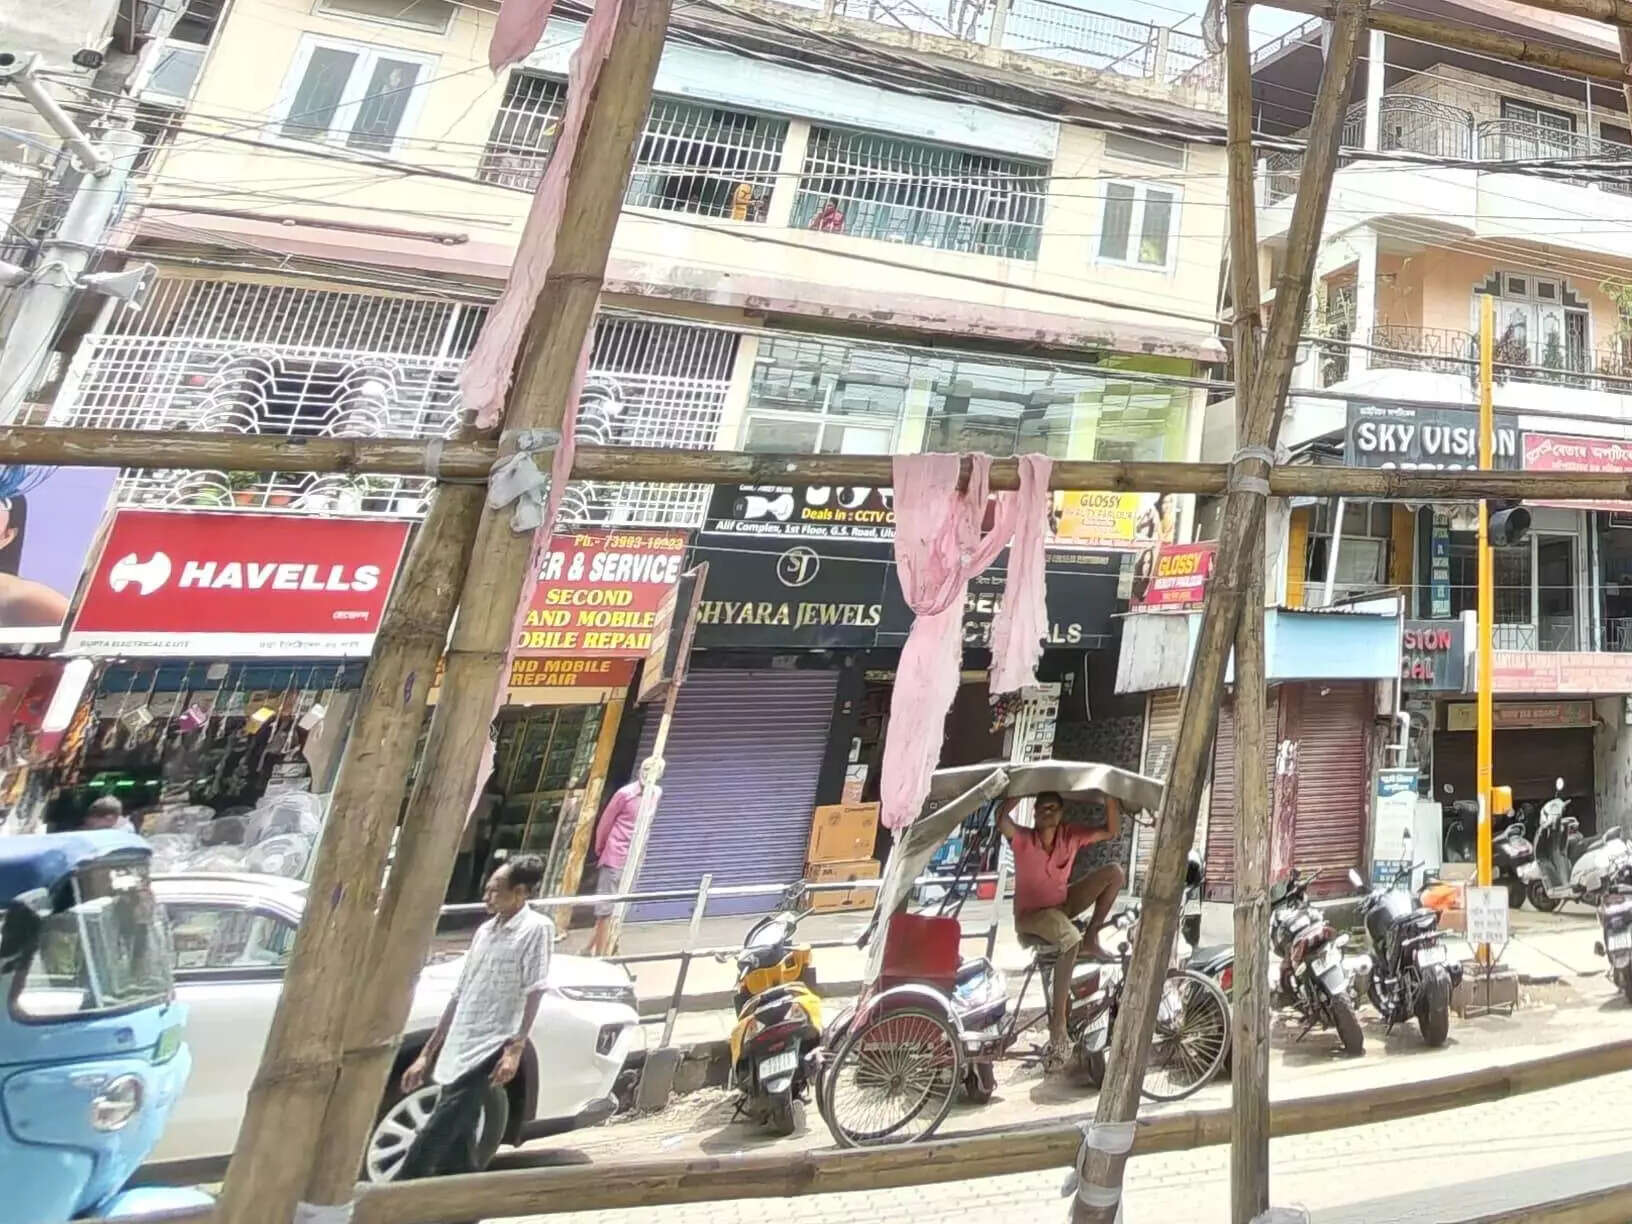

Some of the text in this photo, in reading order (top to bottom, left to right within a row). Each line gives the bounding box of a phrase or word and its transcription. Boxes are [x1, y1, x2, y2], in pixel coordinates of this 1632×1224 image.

[1358, 422, 1415, 452] SKY
[1080, 493, 1122, 509] GLOSSY
[801, 507, 834, 521] Deals
[835, 509, 846, 521] in
[854, 510, 885, 523] CCTV
[715, 521, 734, 531] Alif
[736, 522, 782, 534] Complex,
[784, 524, 799, 534] 1st
[801, 525, 828, 536] Floor,
[851, 527, 878, 538] Road,
[567, 551, 585, 582] &
[588, 552, 682, 584] SERVICE
[1159, 552, 1203, 577] GLOSSY
[178, 560, 381, 593] HAVELLS
[545, 588, 634, 607] SECOND
[522, 609, 656, 628] AND MOBILE
[792, 602, 882, 631] JEWELS
[515, 631, 578, 649] OBILE
[1404, 627, 1453, 650] SION
[544, 660, 612, 673] MOBILE
[509, 673, 578, 686] REPAIR
